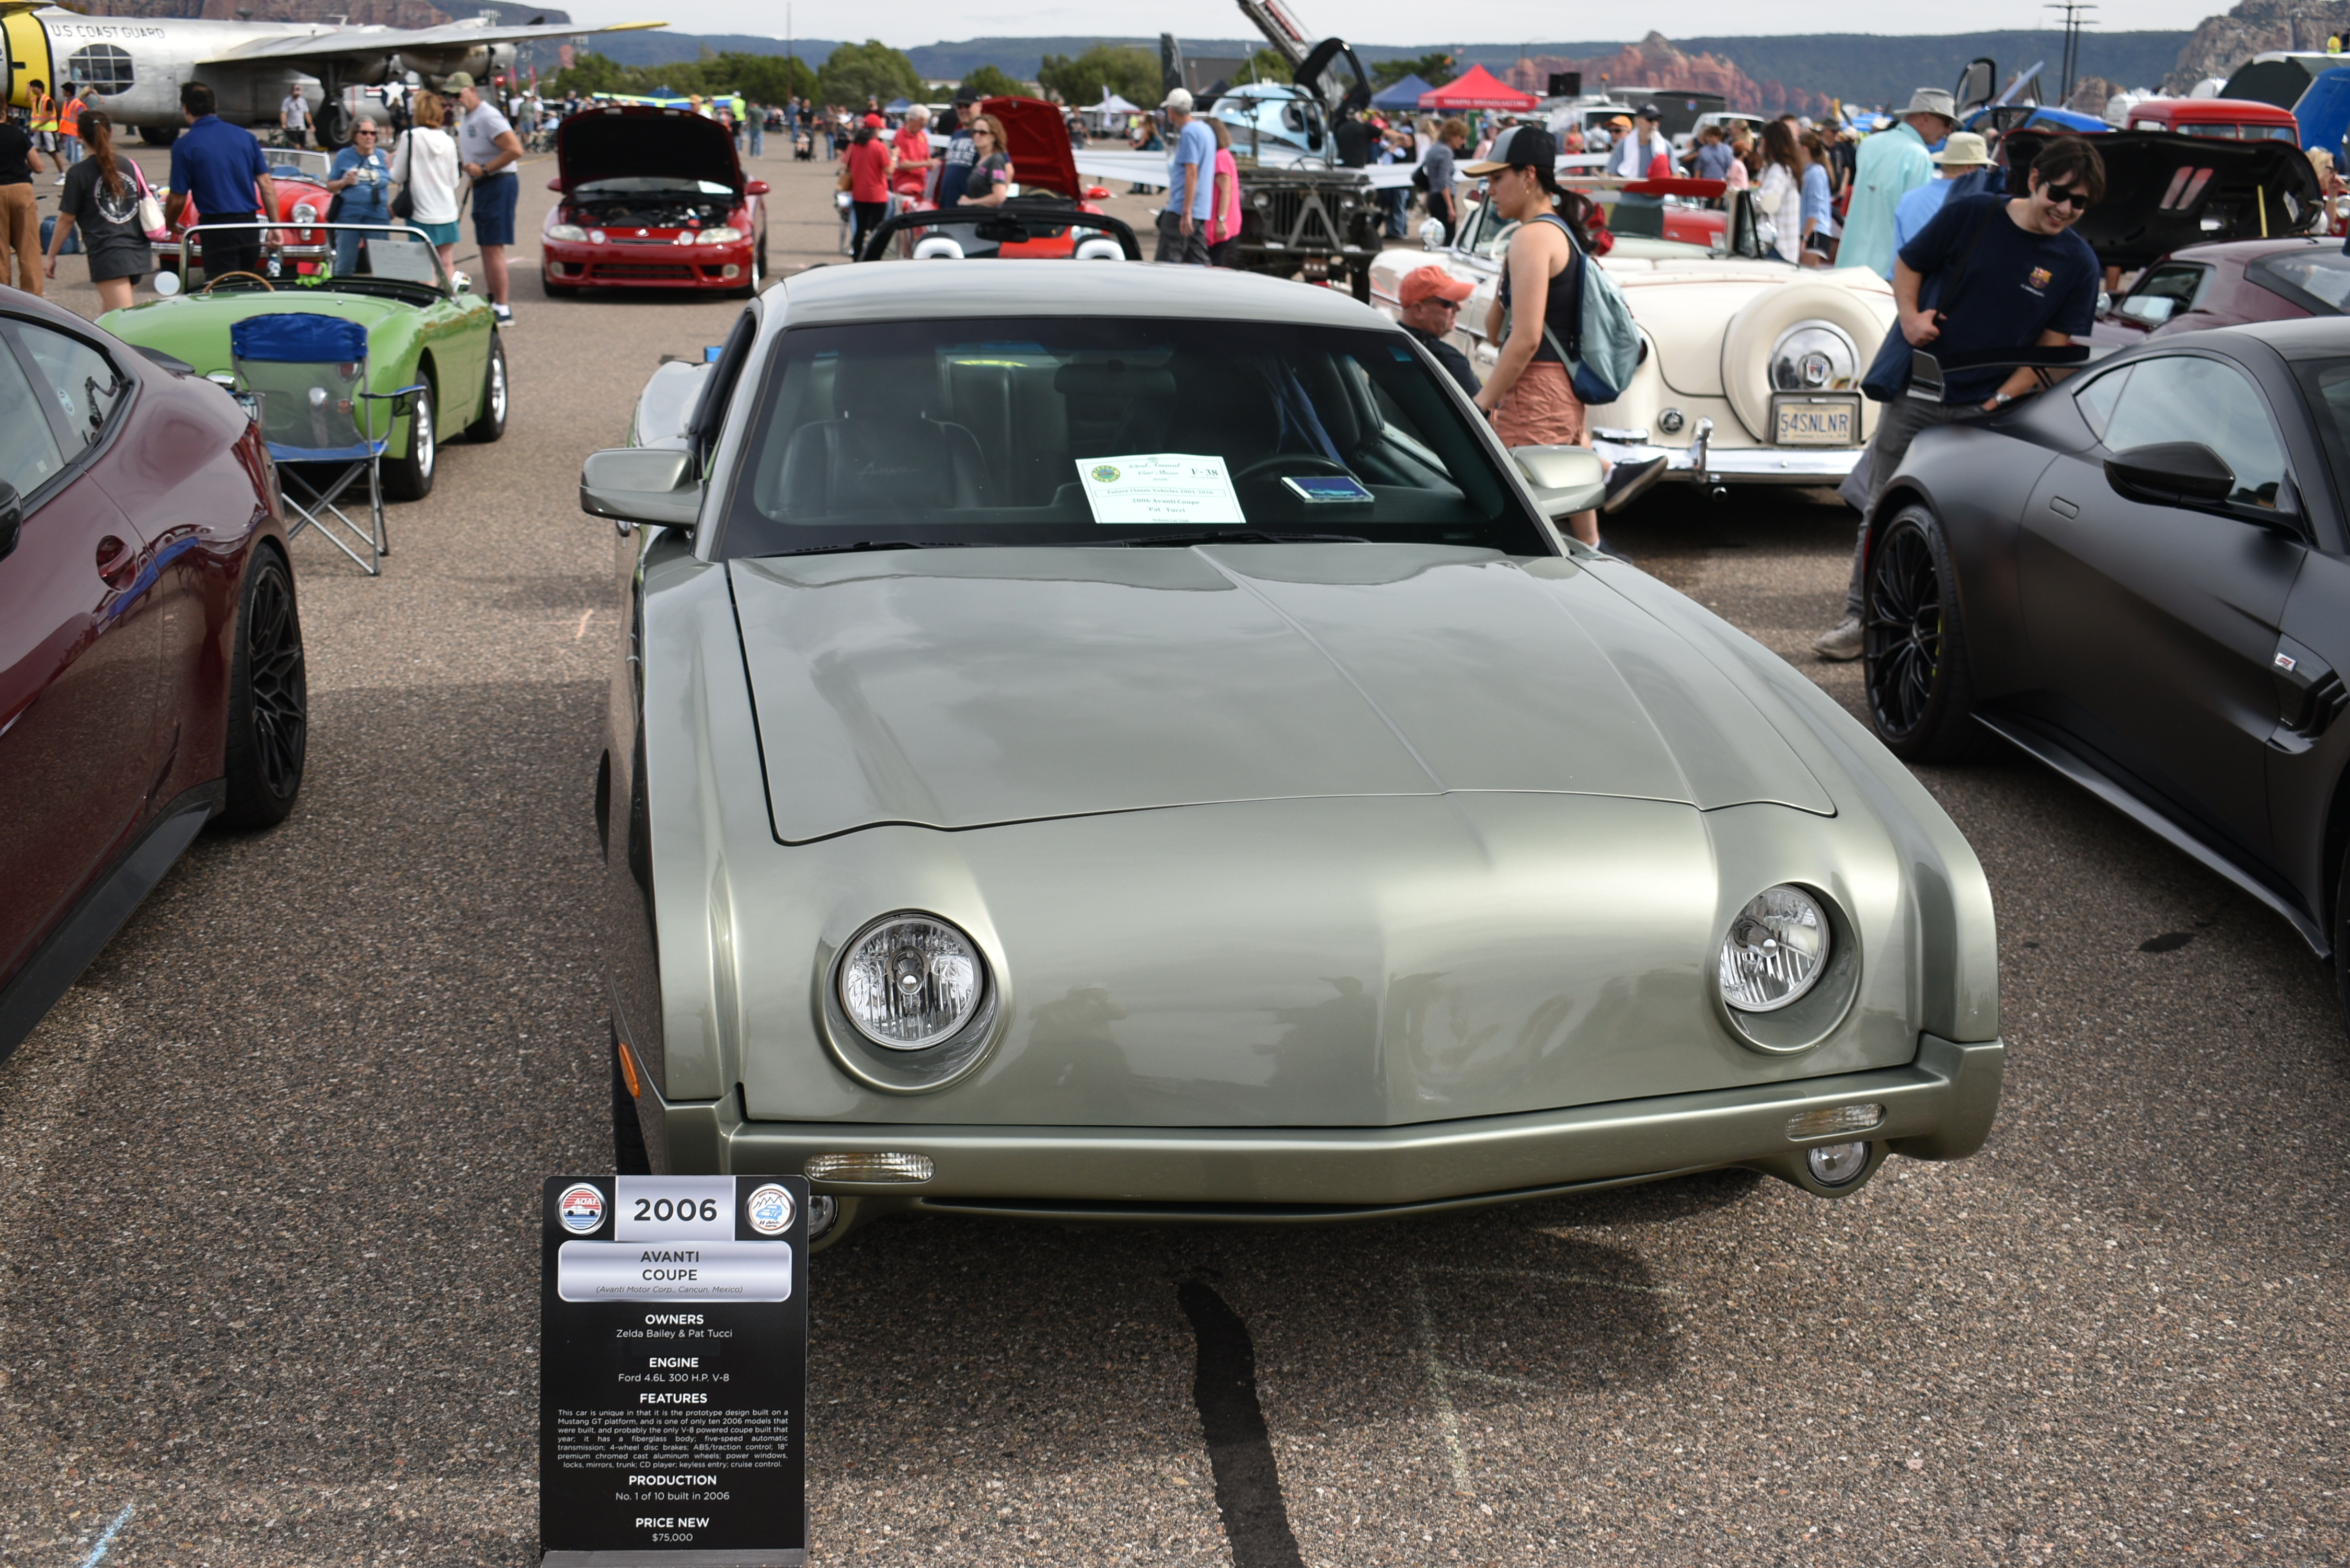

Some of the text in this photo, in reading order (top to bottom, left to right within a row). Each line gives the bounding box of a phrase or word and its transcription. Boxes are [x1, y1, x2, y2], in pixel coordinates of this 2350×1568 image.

[51, 24, 166, 39] U.S. COAST GUARD
[1780, 413, 1849, 432] 54SNLNR
[634, 1198, 717, 1221] 2006
[640, 1251, 699, 1263] AVANTI
[642, 1269, 697, 1281] COUPE
[596, 1286, 625, 1294] (Avanti
[652, 1286, 676, 1295] Corp.,
[712, 1286, 743, 1294] Mexico)
[645, 1314, 704, 1325] OWNERS
[616, 1329, 732, 1339] Zelda Bailey & Pat Tucci
[649, 1357, 699, 1368] ENGINE
[618, 1373, 730, 1382] Ford 4.6L 300 H.P. V-8
[640, 1393, 708, 1404] FEATURES
[614, 1426, 647, 1435] probably
[631, 1435, 667, 1443] fiberglass
[629, 1475, 717, 1486] PRODUCTION
[616, 1492, 632, 1501] No.
[641, 1492, 651, 1501] of
[654, 1492, 665, 1501] 10
[667, 1492, 689, 1500] built
[692, 1492, 700, 1500] in
[704, 1492, 730, 1500] 2006
[636, 1517, 710, 1528] PRICE NEW
[652, 1533, 693, 1542] $75,000
